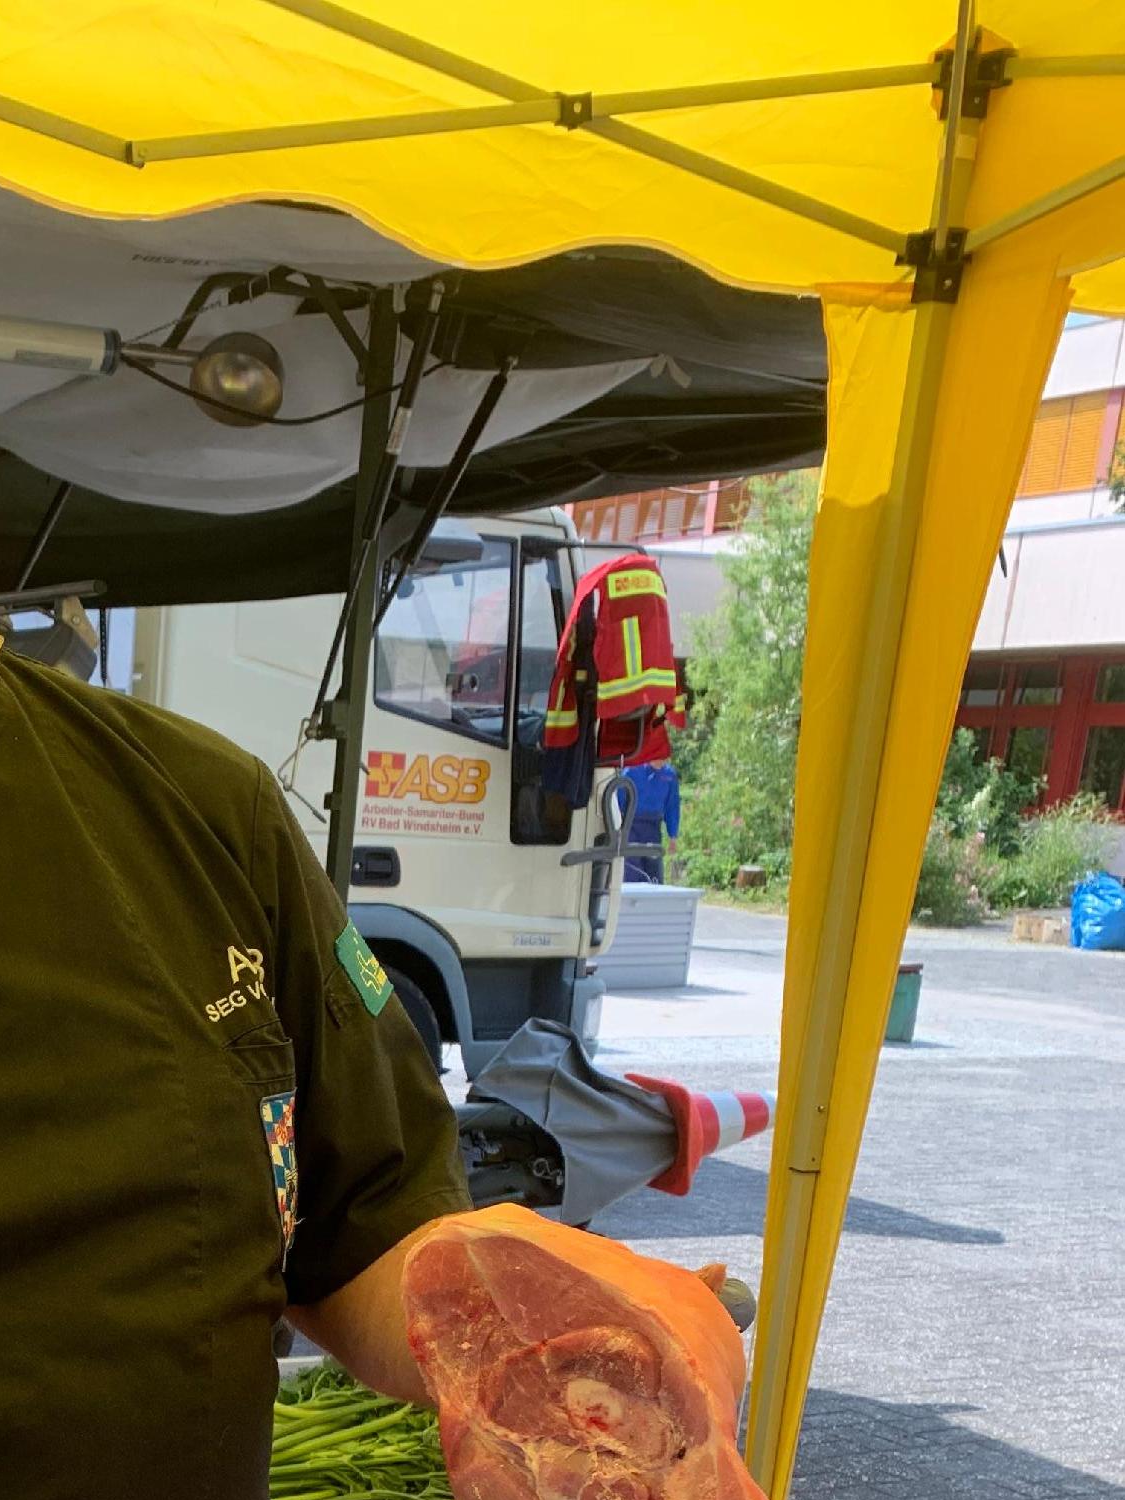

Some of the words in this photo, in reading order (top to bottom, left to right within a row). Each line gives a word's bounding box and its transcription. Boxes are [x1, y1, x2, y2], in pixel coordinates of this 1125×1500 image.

[392, 753, 491, 804] ASB
[361, 804, 485, 820] Arbeiter-Samariter-Bund
[378, 817, 400, 830] Bad
[403, 819, 461, 833] Windsheim
[205, 989, 247, 1023] SEG
